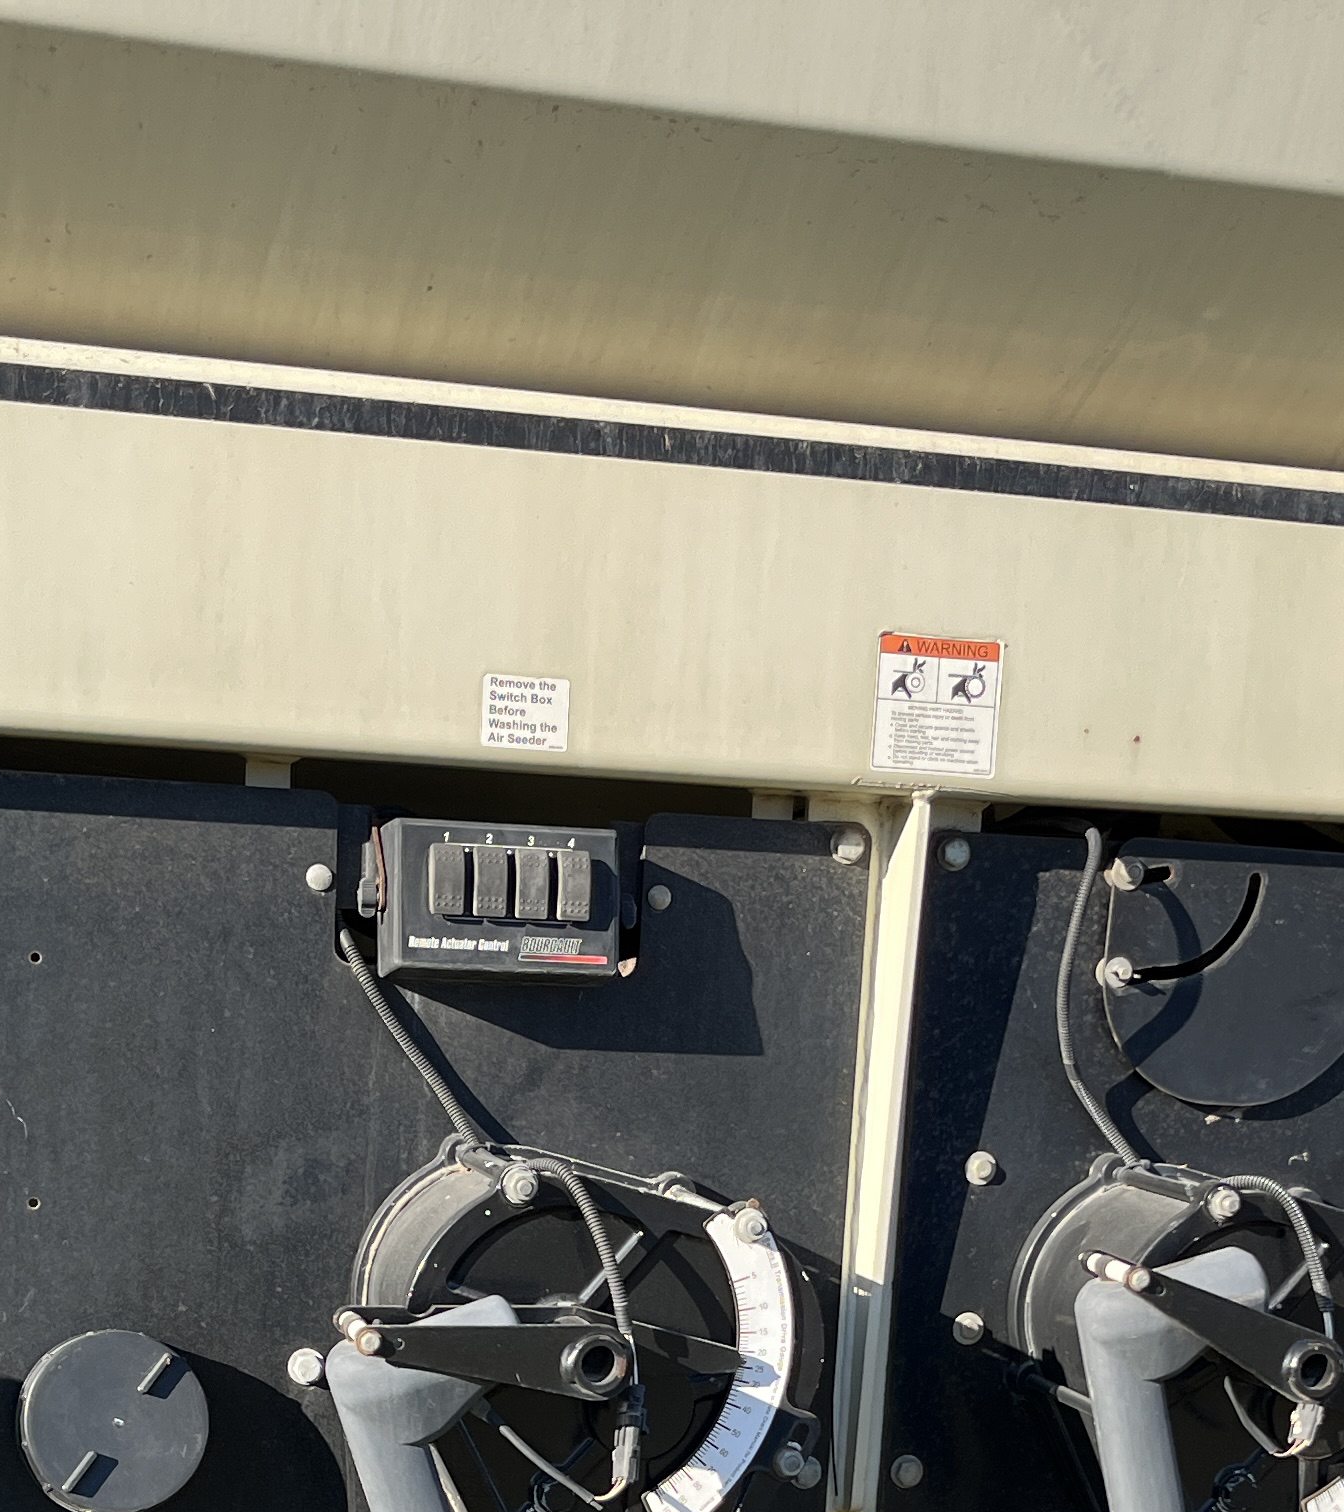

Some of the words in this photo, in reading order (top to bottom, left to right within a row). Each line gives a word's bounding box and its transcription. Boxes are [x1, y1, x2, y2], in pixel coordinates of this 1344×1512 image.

[917, 640, 988, 658] WARNING
[490, 677, 536, 690] Remove
[539, 681, 556, 691] the
[489, 690, 527, 703] Switch
[531, 693, 552, 705] Box
[489, 704, 526, 717] Before
[488, 718, 536, 734] Washing
[540, 722, 557, 733] the
[487, 732, 504, 743] Air
[507, 733, 547, 745] Seeder
[443, 831, 450, 843] 1
[485, 833, 493, 845] 2
[527, 835, 535, 847] 3
[567, 837, 575, 849] 4
[408, 935, 439, 949] Remote
[441, 937, 477, 951] Actuator
[477, 939, 509, 952] Control
[520, 936, 583, 955] BOURGAULT
[751, 1271, 757, 1280] 5
[759, 1302, 768, 1310] 10
[756, 1348, 767, 1357] 20
[742, 1405, 752, 1415] 40
